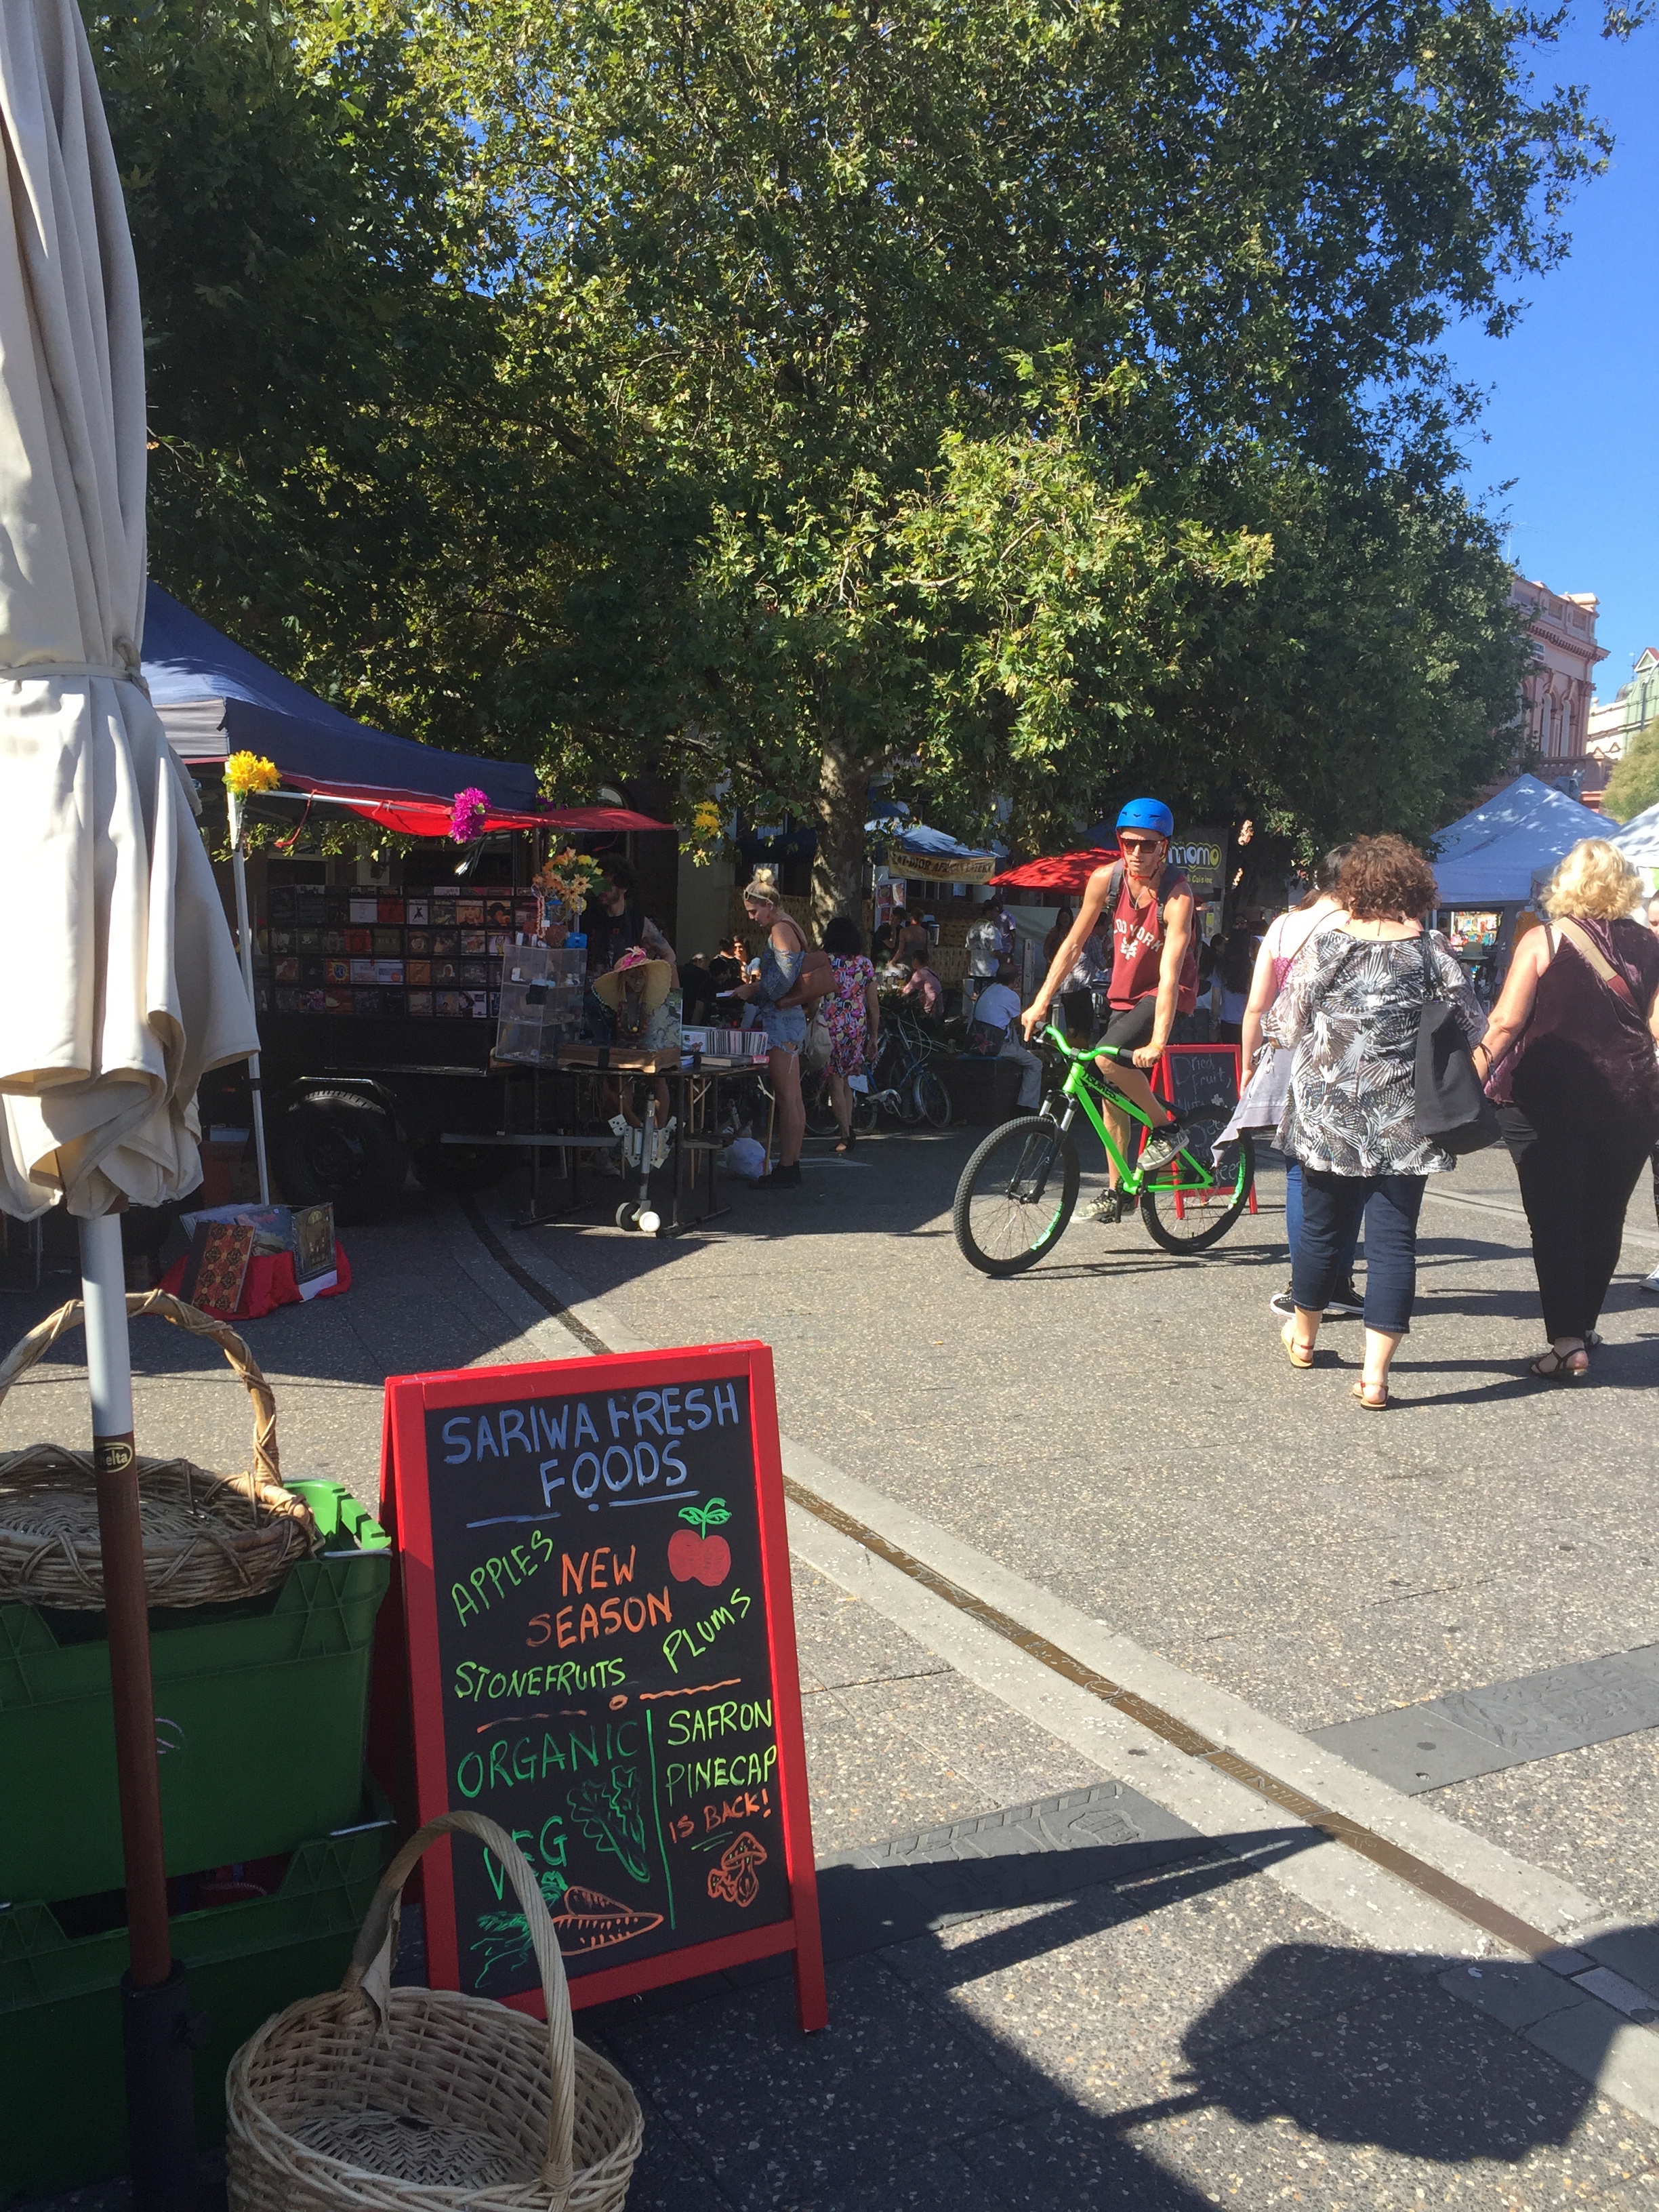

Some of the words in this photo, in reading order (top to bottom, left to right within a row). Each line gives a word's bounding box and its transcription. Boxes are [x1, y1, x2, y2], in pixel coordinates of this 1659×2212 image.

[1130, 924, 1164, 952] YORK
[1172, 1053, 1214, 1087] Dried
[442, 1402, 599, 1465] SARIWA
[608, 1382, 739, 1438] FRESH
[539, 1440, 688, 1507] FOODS
[451, 1530, 553, 1626] APPLES
[562, 1544, 636, 1597] NEW
[526, 1586, 673, 1648] SEASON
[663, 1588, 752, 1673] PLUMS
[454, 1658, 627, 1702] STONEFRUITS
[668, 1699, 772, 1745] SAFRON
[457, 1721, 639, 1798] ORGANIC
[665, 1744, 777, 1807] PINECAP
[669, 1815, 695, 1843] IS
[703, 1788, 772, 1832] BACK!
[483, 1816, 569, 1901] VEG
